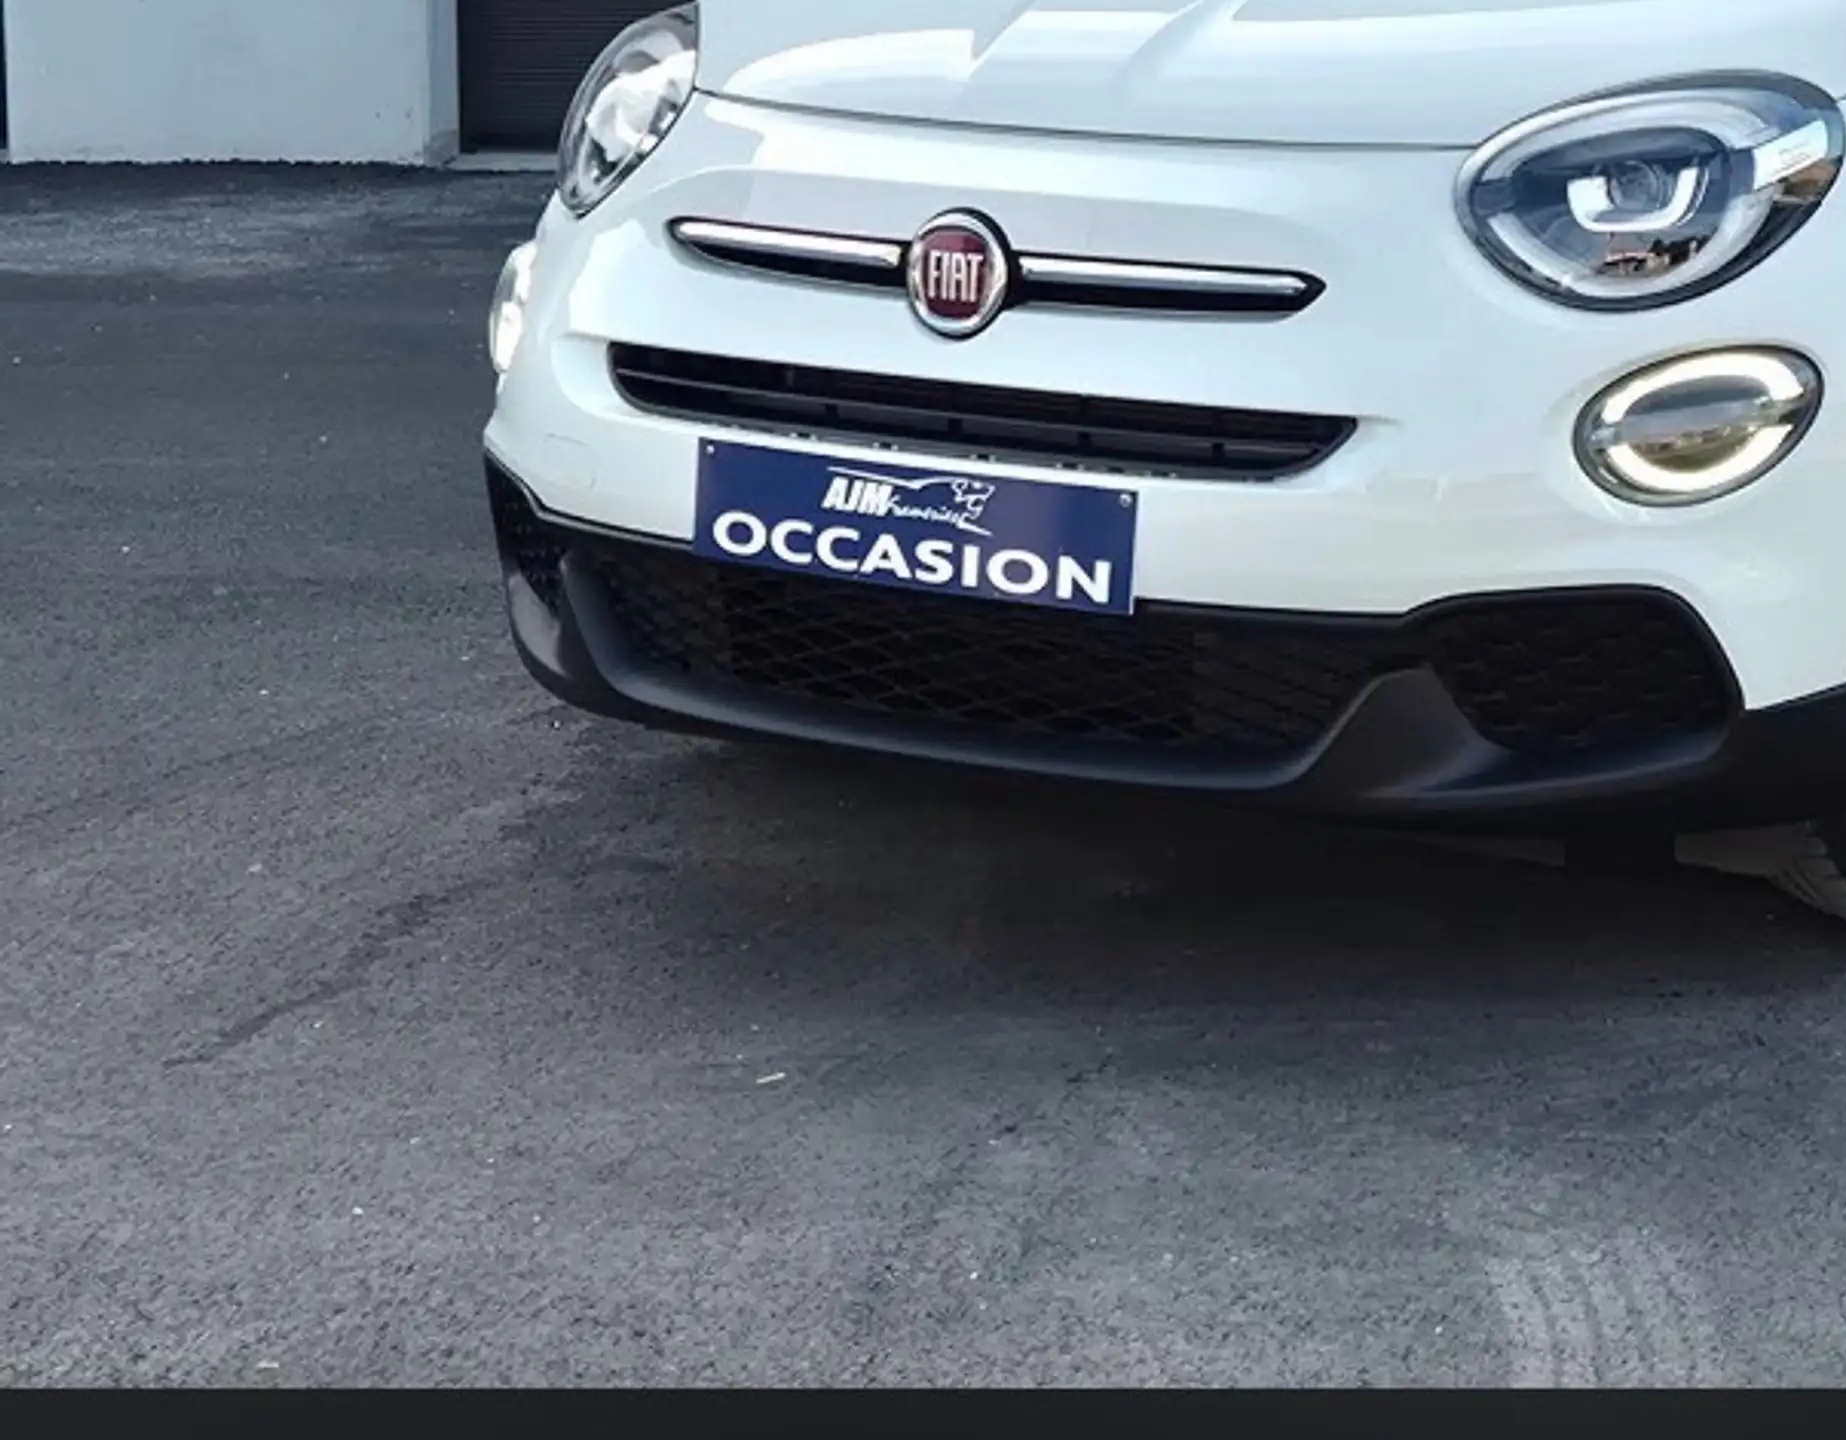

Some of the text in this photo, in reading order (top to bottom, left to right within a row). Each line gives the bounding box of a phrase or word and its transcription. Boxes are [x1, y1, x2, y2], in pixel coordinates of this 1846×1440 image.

[928, 249, 984, 303] FIAT
[821, 475, 893, 517] AJM
[712, 510, 1113, 604] OCCASION
